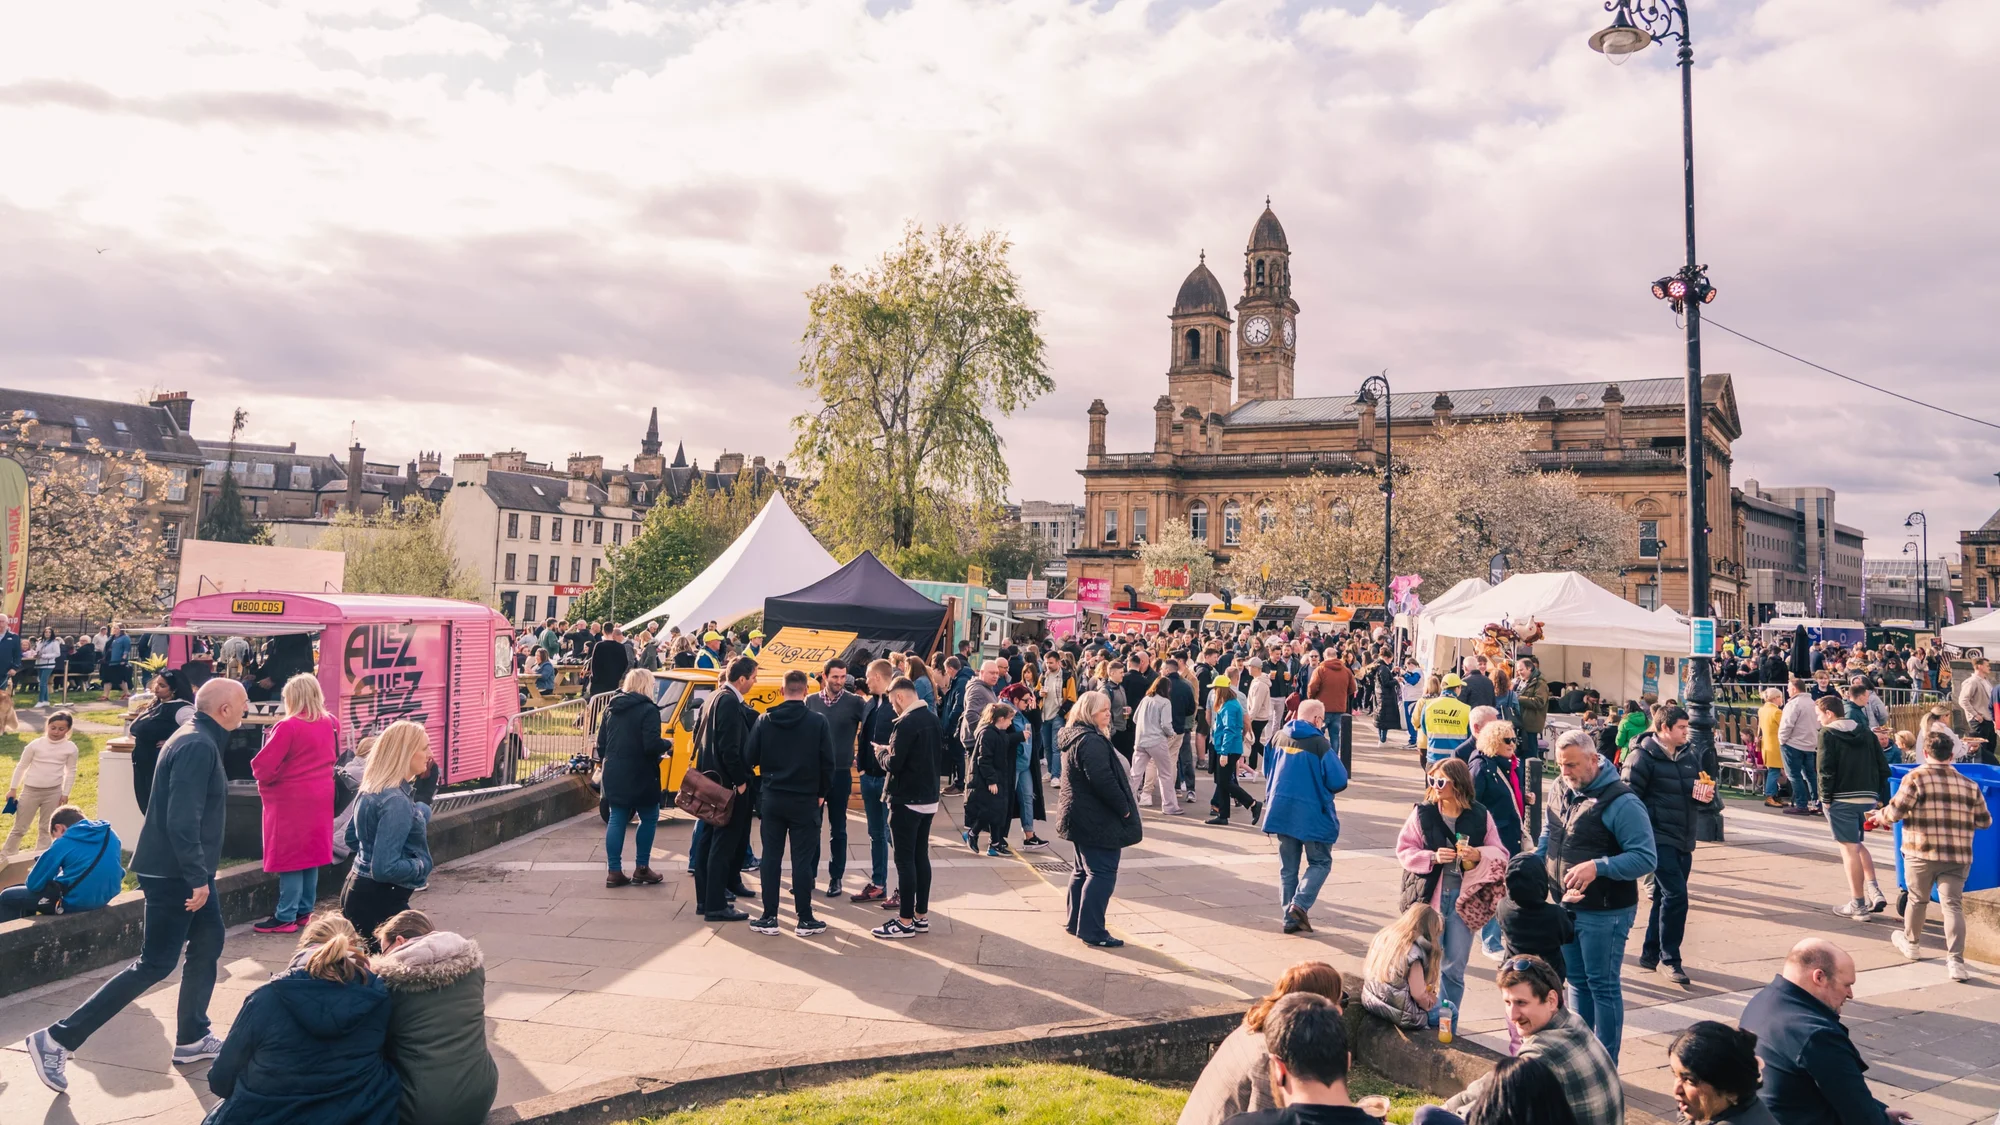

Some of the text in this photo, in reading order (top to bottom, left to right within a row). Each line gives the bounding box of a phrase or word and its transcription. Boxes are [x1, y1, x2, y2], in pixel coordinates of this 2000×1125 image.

[9, 505, 21, 555] SHACK
[7, 560, 18, 594] RUM
[237, 602, 279, 611] W800 CDS
[344, 624, 417, 684] ALLEZ
[451, 628, 463, 774] CAFFEINE PEDALERS
[1433, 718, 1461, 726] STEWARD
